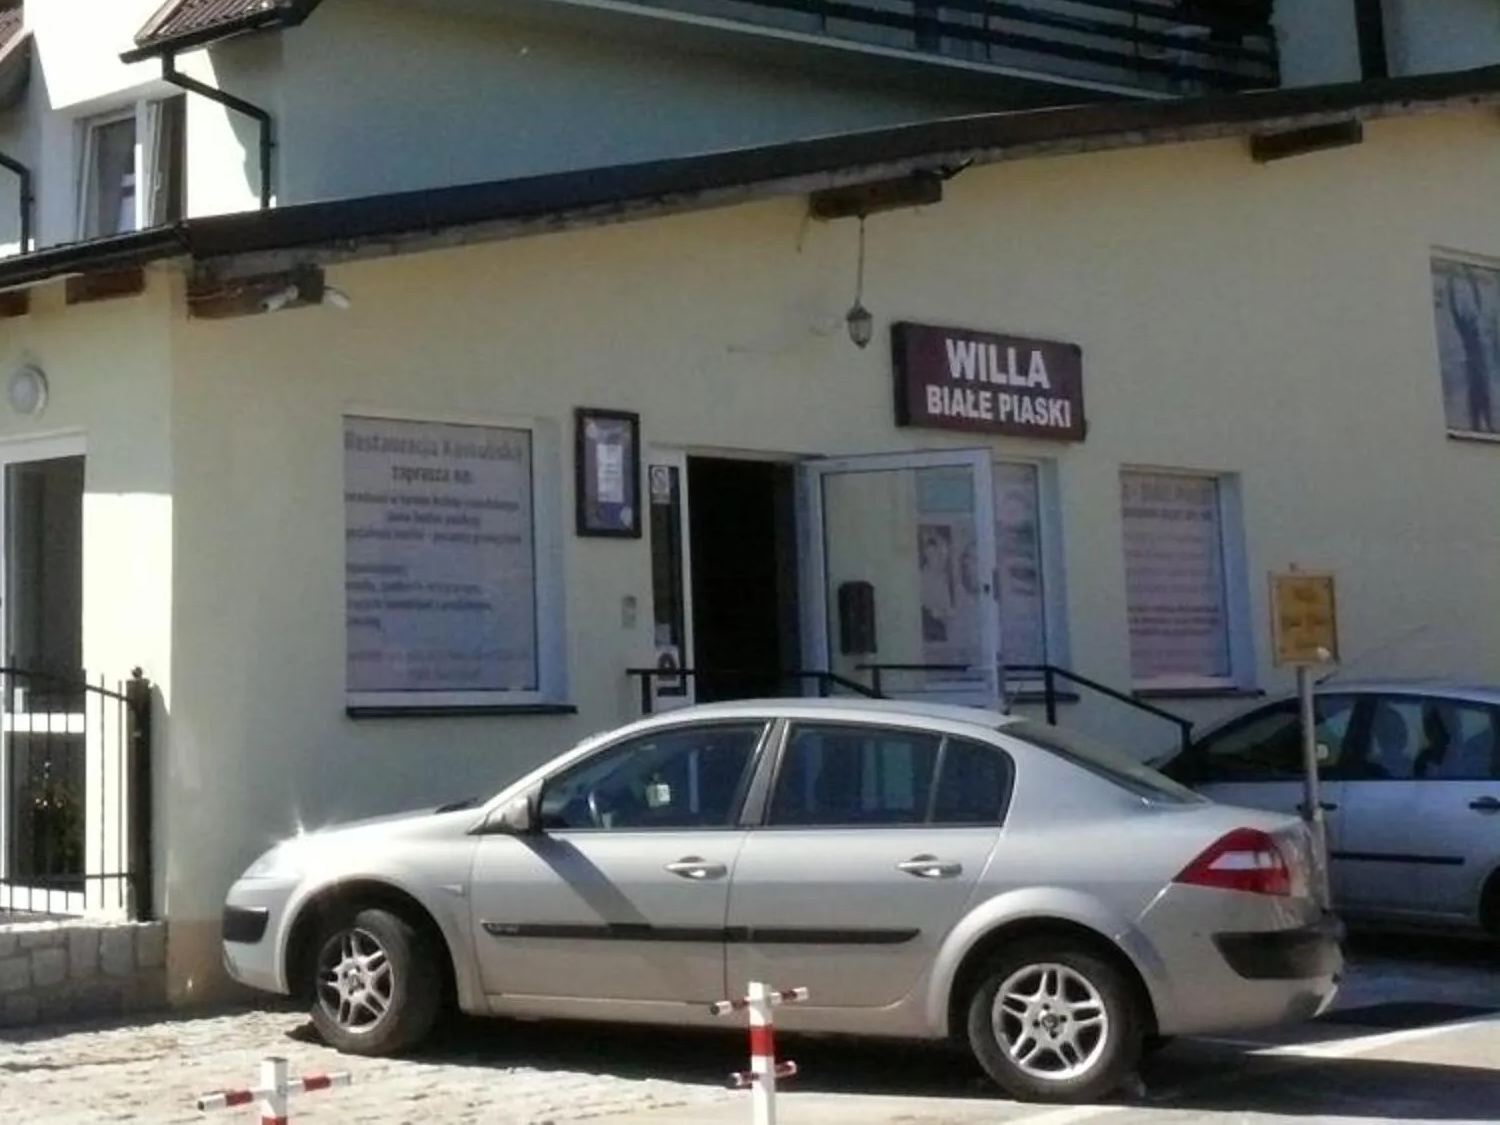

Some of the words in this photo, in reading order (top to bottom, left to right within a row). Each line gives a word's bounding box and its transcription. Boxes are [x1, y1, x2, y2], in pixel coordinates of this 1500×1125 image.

[946, 338, 1050, 388] WILLA
[926, 385, 994, 420] BIAŁE
[1000, 392, 1072, 428] PIASKI
